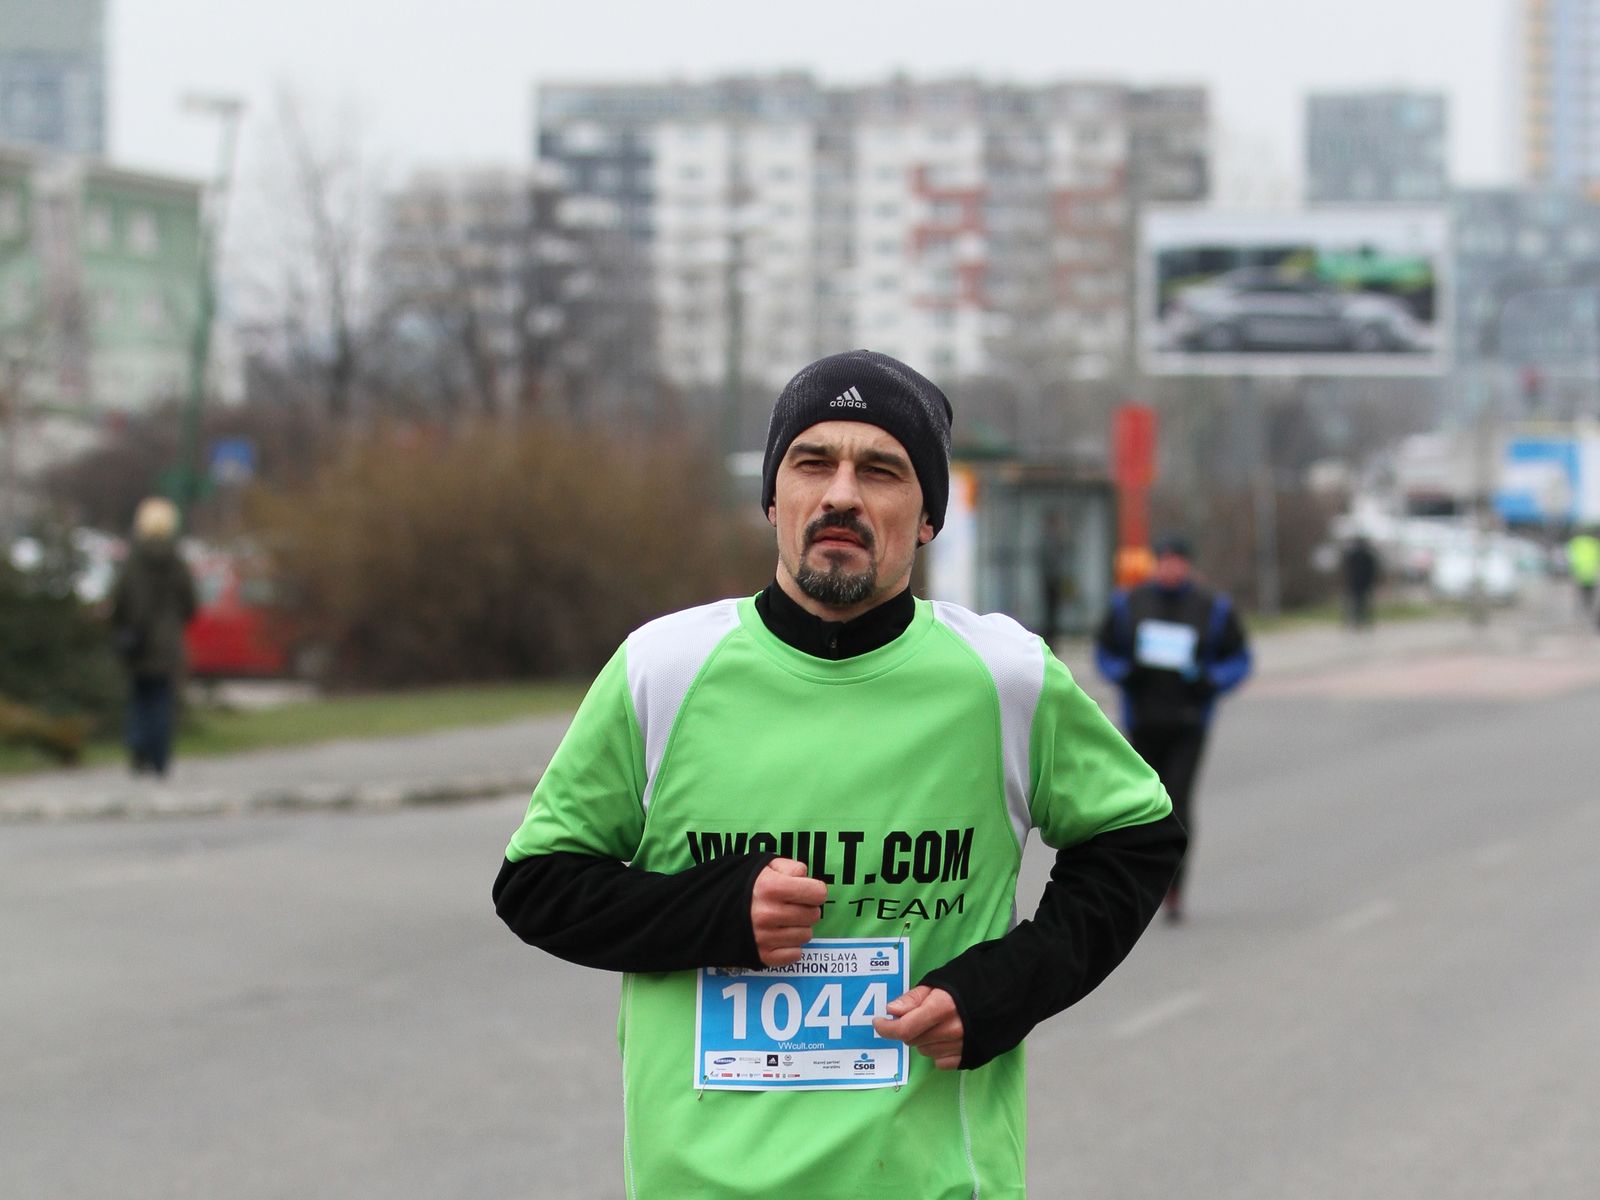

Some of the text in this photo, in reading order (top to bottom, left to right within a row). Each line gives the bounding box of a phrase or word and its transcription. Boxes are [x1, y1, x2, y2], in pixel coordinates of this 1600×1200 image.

[830, 399, 867, 409] adidas
[849, 893, 964, 920] TEAM
[800, 953, 858, 961] RATISLAVA
[830, 962, 858, 973] 2013
[722, 982, 894, 1041] 1044
[778, 1042, 825, 1050] VWcult.com
